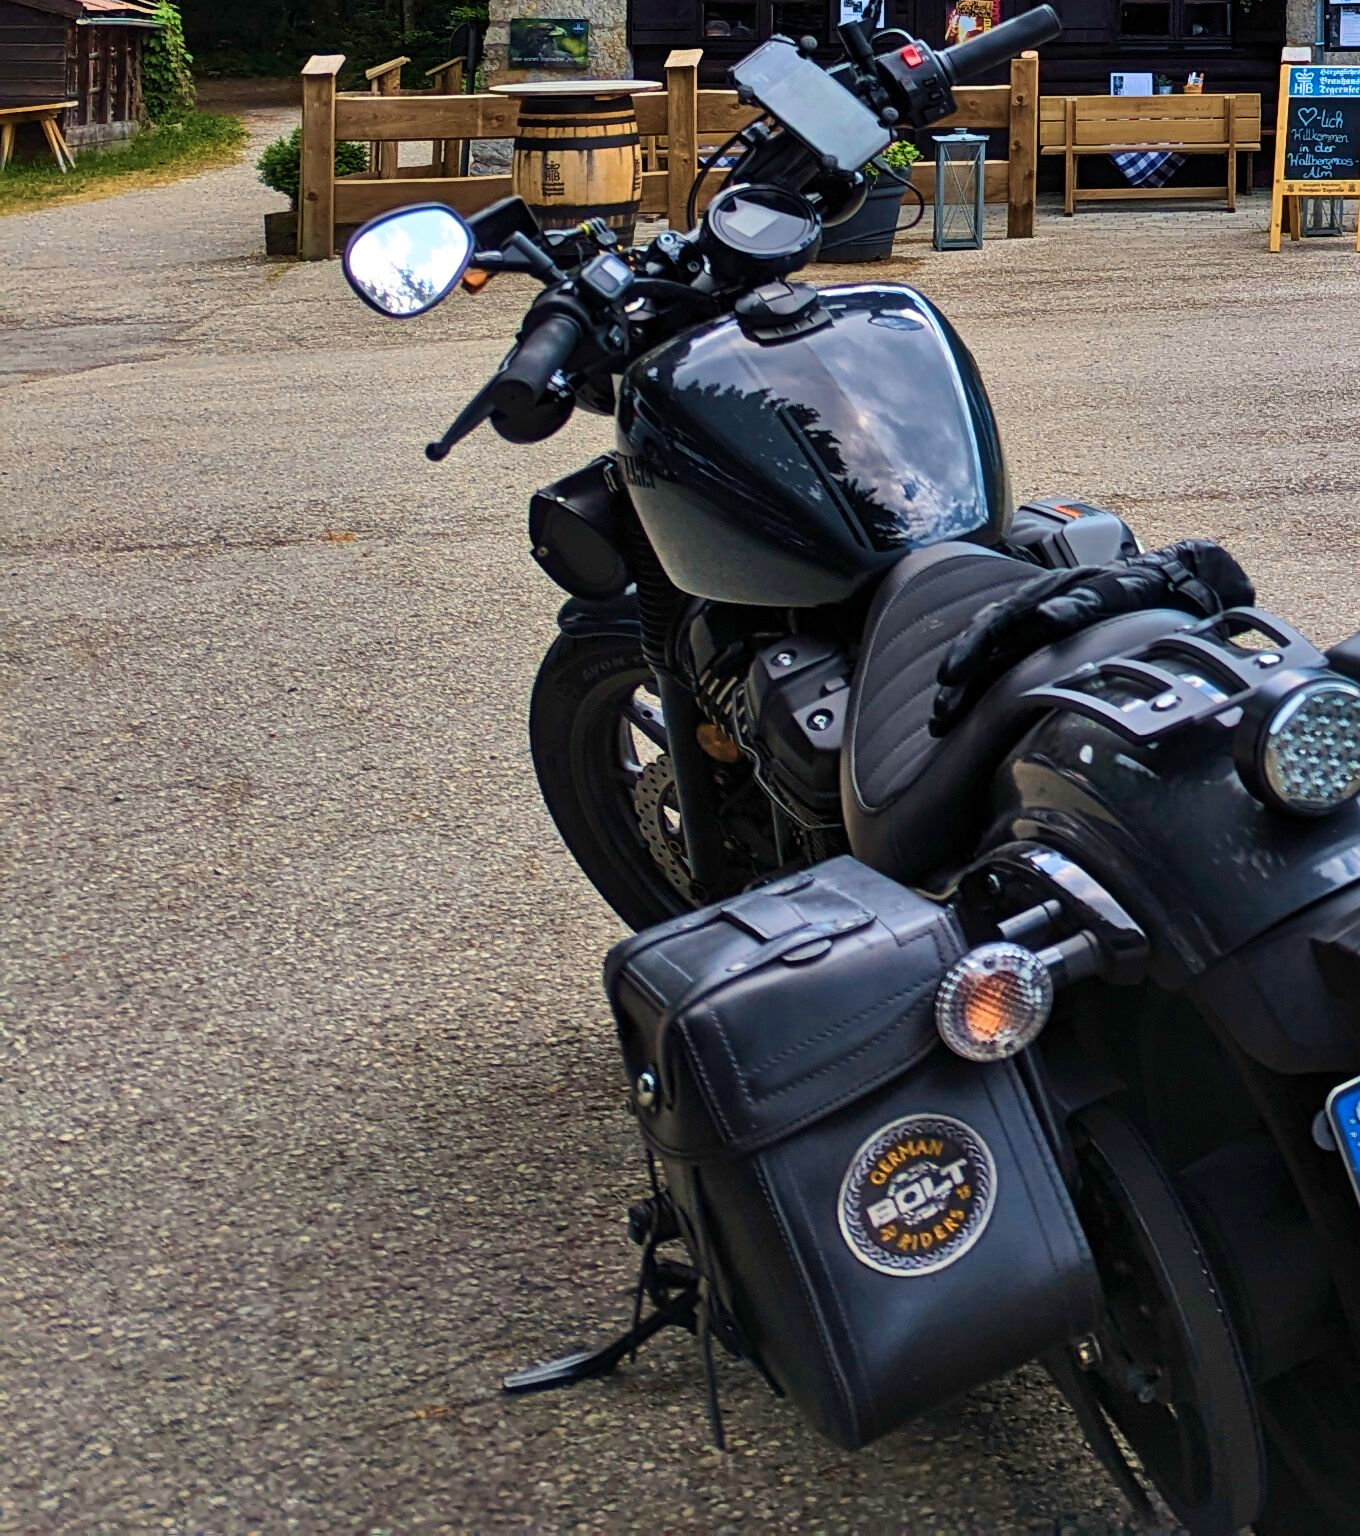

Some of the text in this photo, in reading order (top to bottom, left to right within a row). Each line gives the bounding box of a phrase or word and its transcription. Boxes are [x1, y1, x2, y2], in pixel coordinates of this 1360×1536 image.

[1319, 76, 1360, 85] Brauhaus
[1293, 81, 1314, 96] HTB
[1319, 85, 1360, 96] Tegernsee
[1290, 128, 1349, 143] Willkommen
[1299, 142, 1337, 153] in der
[1303, 166, 1333, 179] Alm
[870, 1138, 945, 1185] GERMAN
[866, 1158, 968, 1229] BOLT
[896, 1208, 965, 1252] RIDERS
